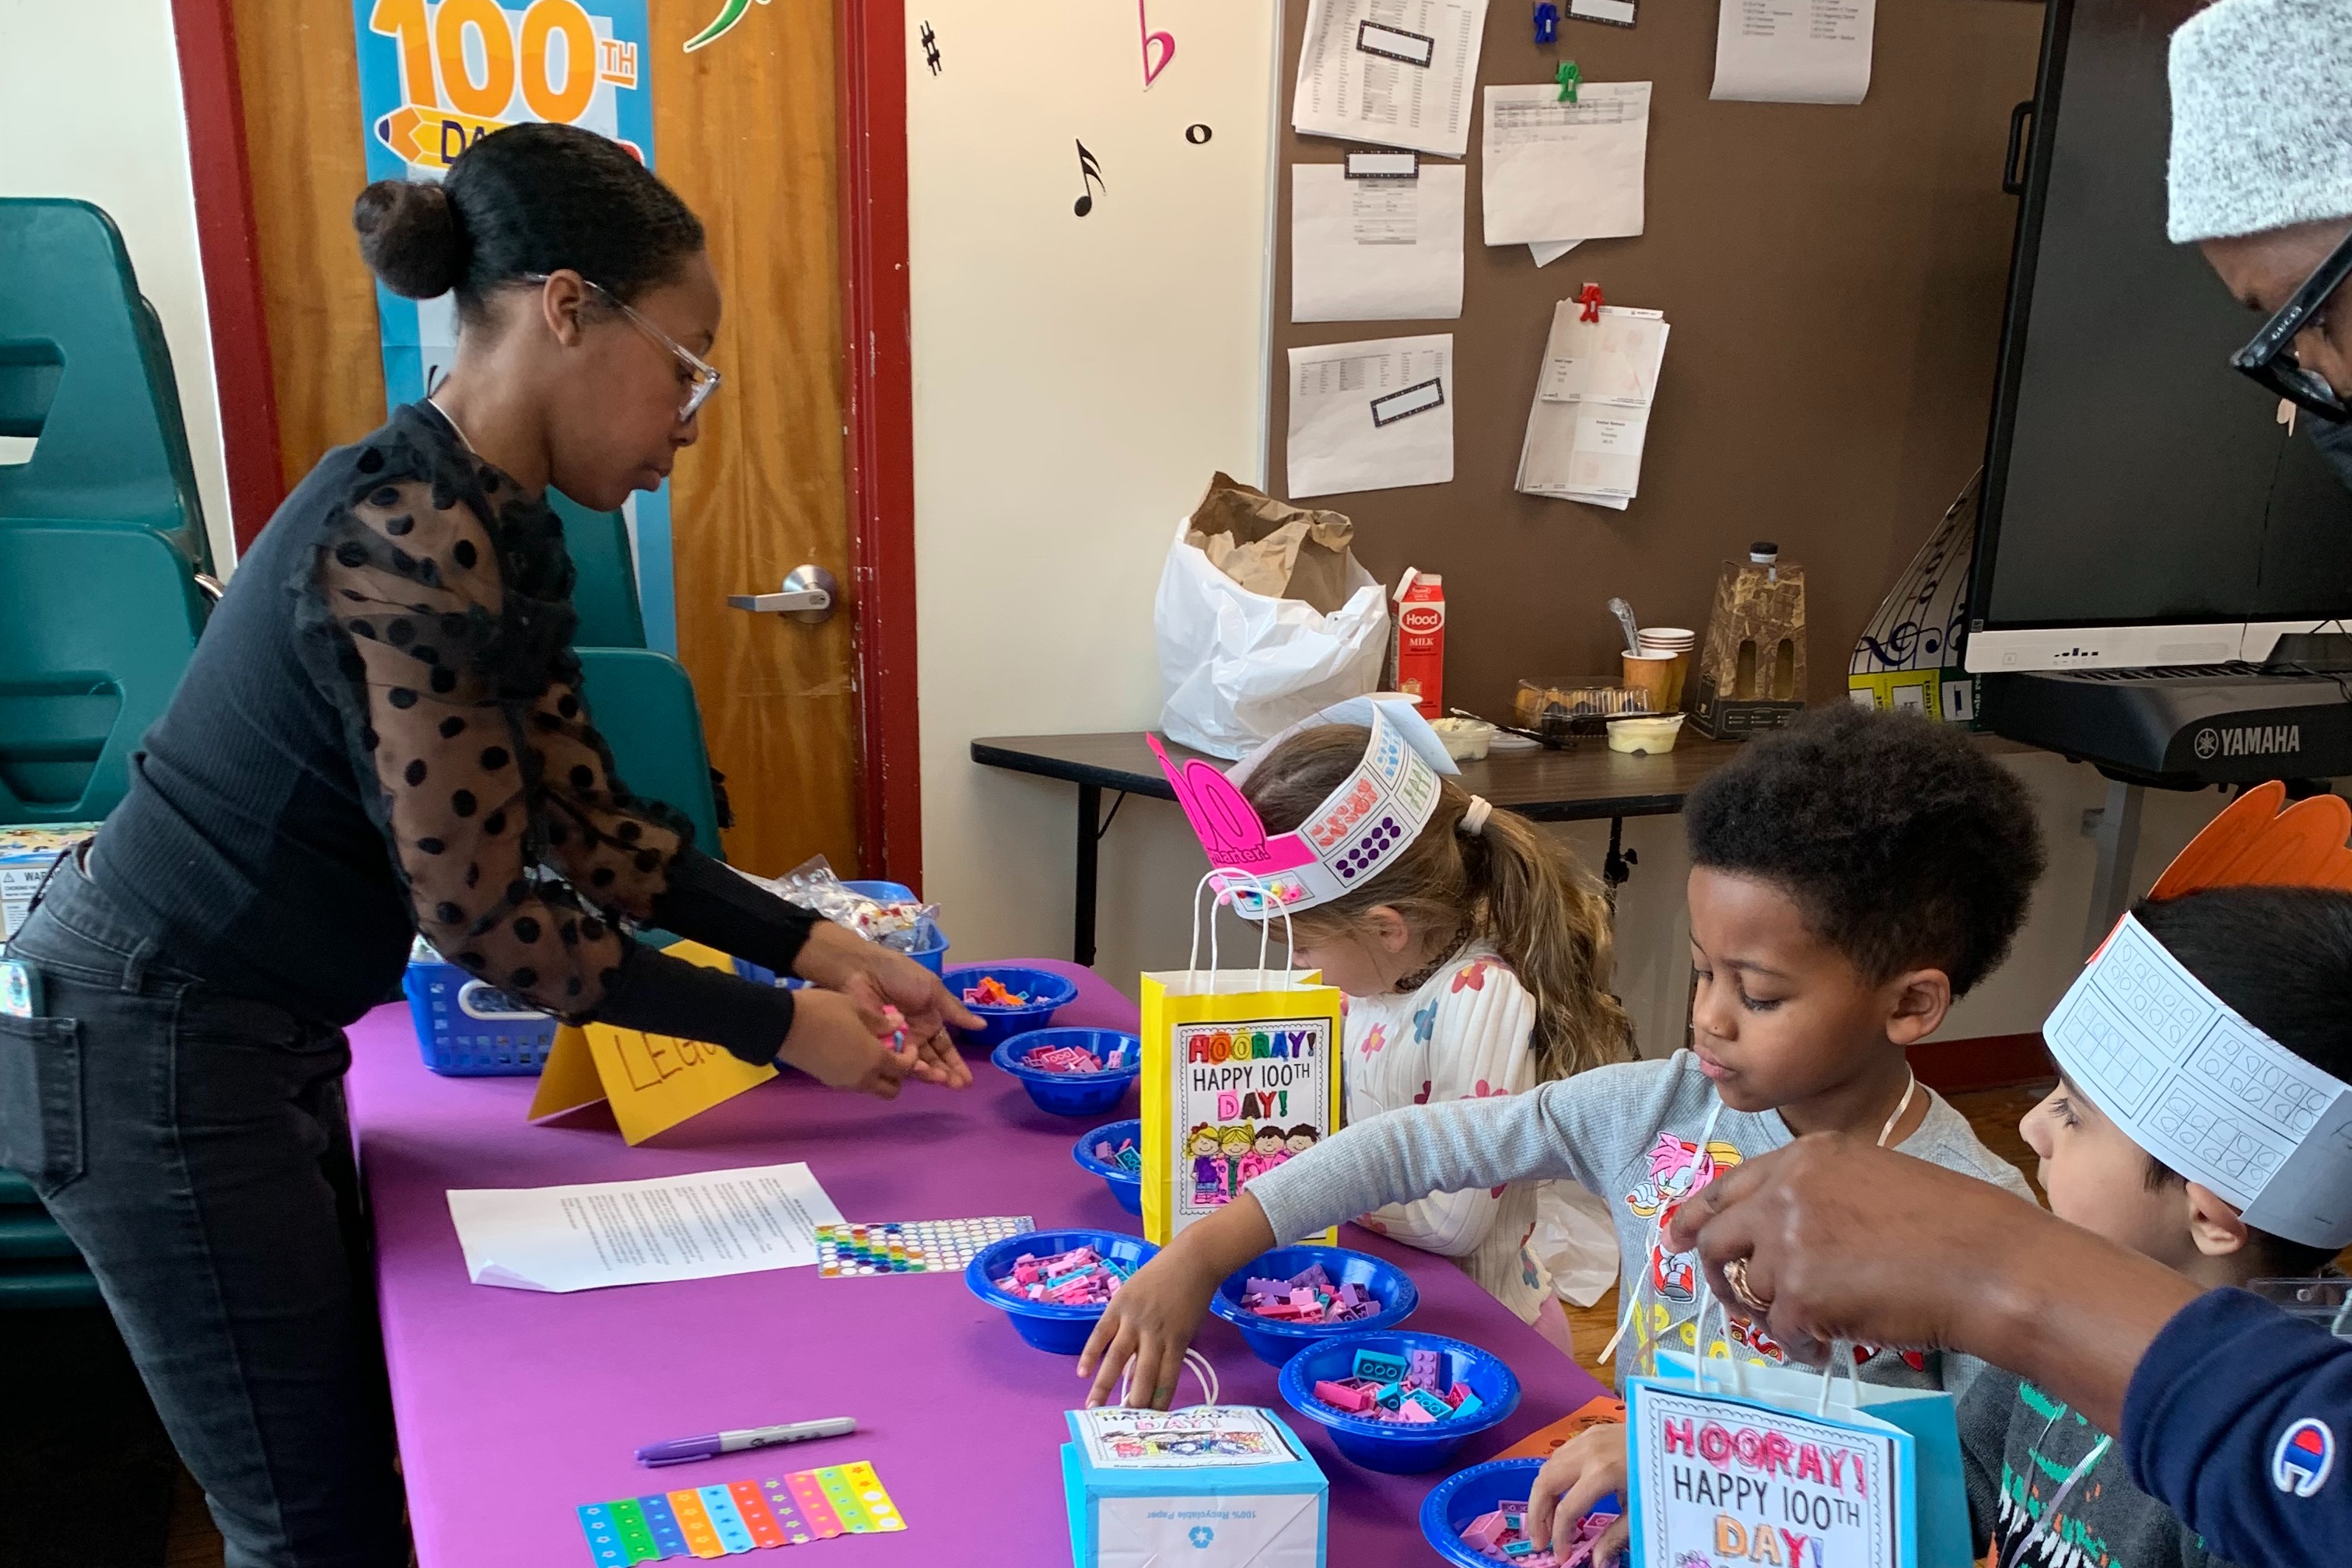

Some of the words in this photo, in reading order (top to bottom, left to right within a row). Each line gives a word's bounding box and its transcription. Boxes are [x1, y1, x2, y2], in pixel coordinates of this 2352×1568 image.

[1406, 614, 1437, 625] Hood
[1409, 638, 1433, 646] MILK
[2221, 725, 2300, 756] YAMAHA
[1210, 845, 1272, 865] marter!
[1188, 1030, 1317, 1064] HOORAY!
[1193, 1066, 1252, 1091] HAPPY
[1262, 1063, 1311, 1087] 100TH
[1217, 1090, 1288, 1121] DAY!
[1664, 1416, 1867, 1499] HOORAY!
[1673, 1465, 1768, 1515] HAPPY
[1783, 1486, 1860, 1531] 100TH
[1147, 1510, 1175, 1520] Paper
[1178, 1510, 1229, 1520] Recyclable
[1231, 1510, 1256, 1519] 100%
[1713, 1514, 1824, 1568] DAY!
